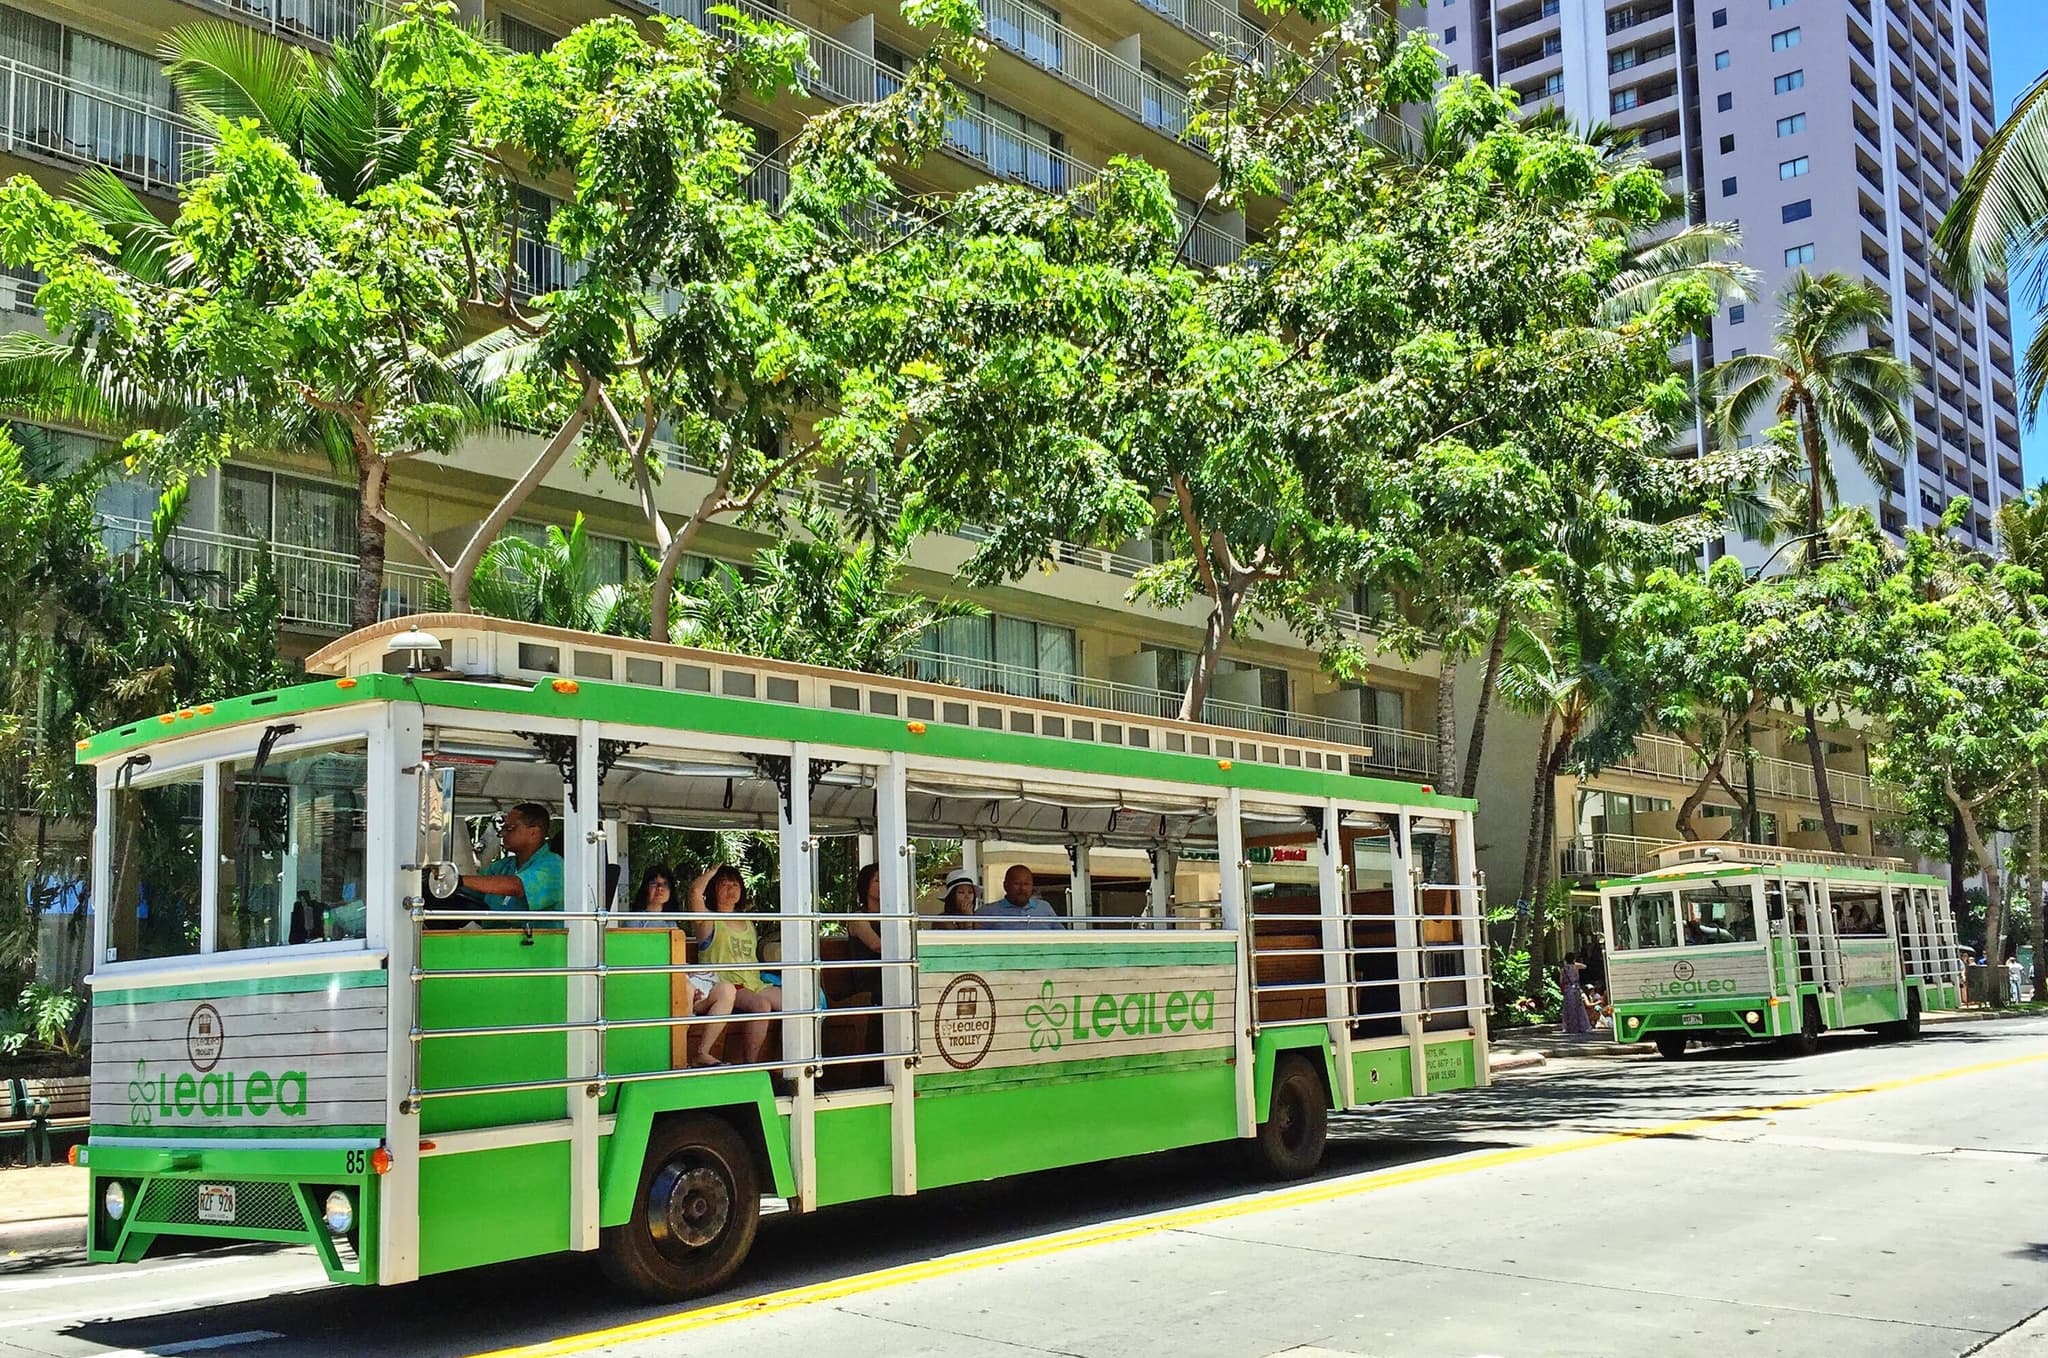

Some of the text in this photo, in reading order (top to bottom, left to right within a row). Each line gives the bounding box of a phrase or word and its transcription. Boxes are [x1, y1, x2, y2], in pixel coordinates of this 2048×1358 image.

[952, 1020, 990, 1033] LeaLea
[1072, 990, 1214, 1039] LeaLea
[949, 1034, 981, 1047] TROLLEY
[159, 1070, 308, 1117] LeaLea
[346, 1149, 365, 1174] 85
